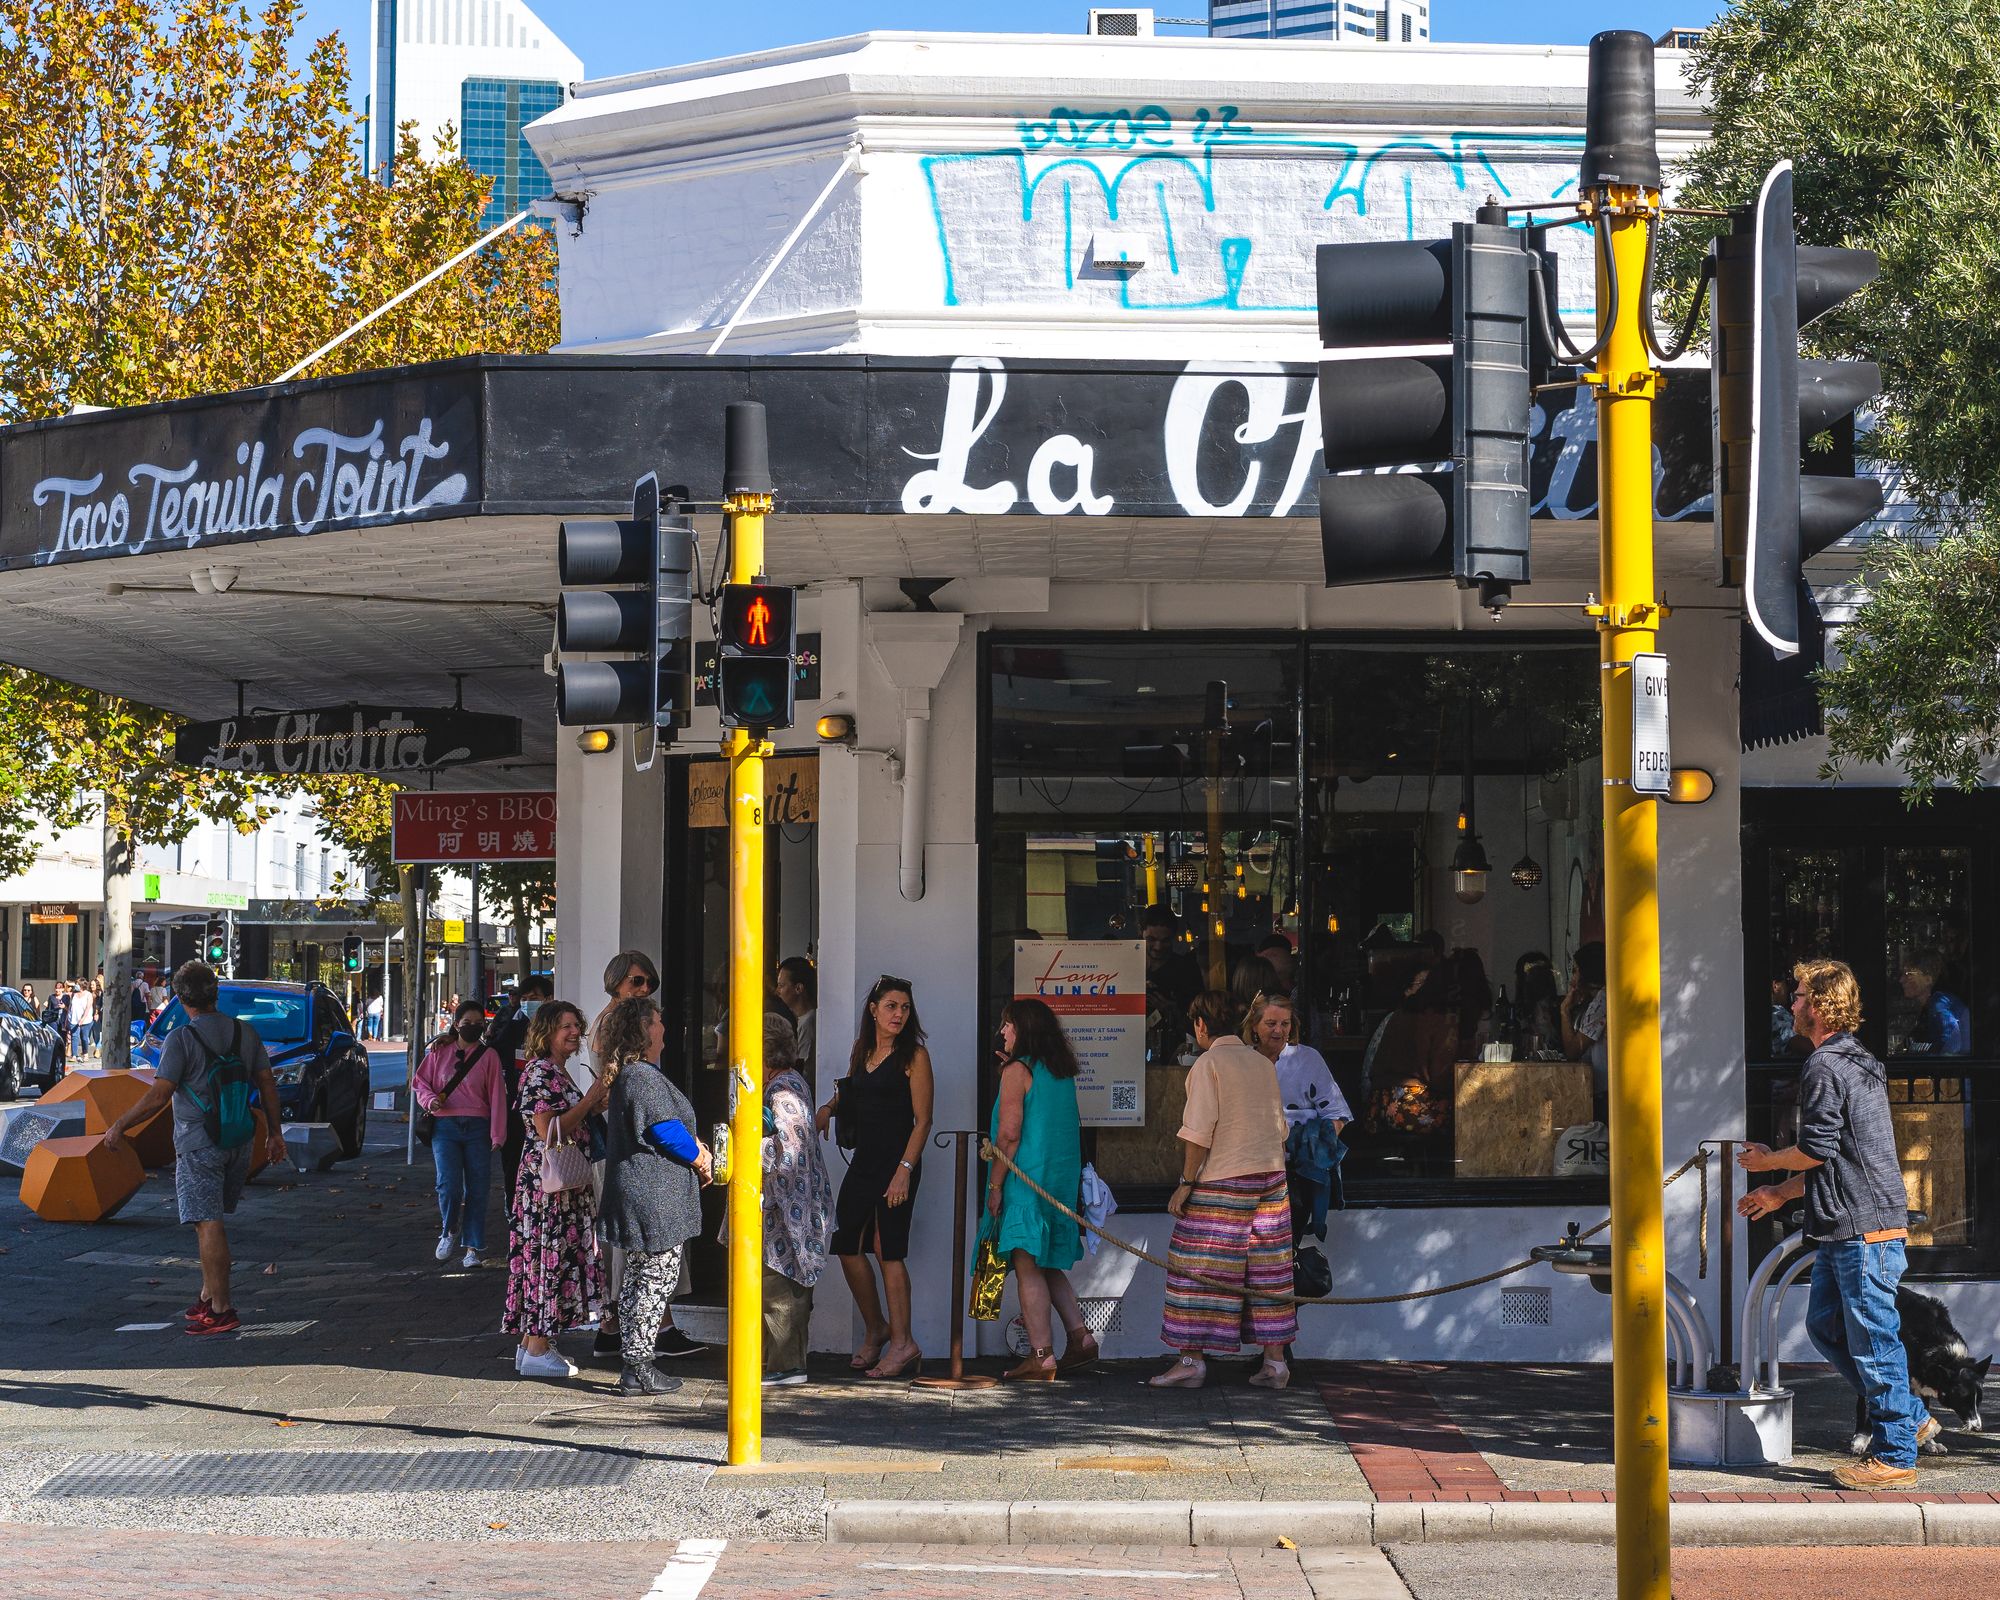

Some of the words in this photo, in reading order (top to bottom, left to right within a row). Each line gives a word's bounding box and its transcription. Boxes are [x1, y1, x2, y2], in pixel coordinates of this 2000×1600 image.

[901, 357, 1114, 515] La
[33, 472, 130, 564] Taco
[128, 441, 284, 555] Tequila
[293, 416, 468, 535] Joint
[201, 721, 265, 772] La
[275, 711, 471, 773] Cholita
[400, 797, 488, 829] Ming's
[499, 796, 556, 823] BBQ
[753, 807, 761, 825] 8
[41, 905, 65, 915] WHISK
[1035, 949, 1119, 995] Long
[1039, 985, 1116, 996] LUNCH
